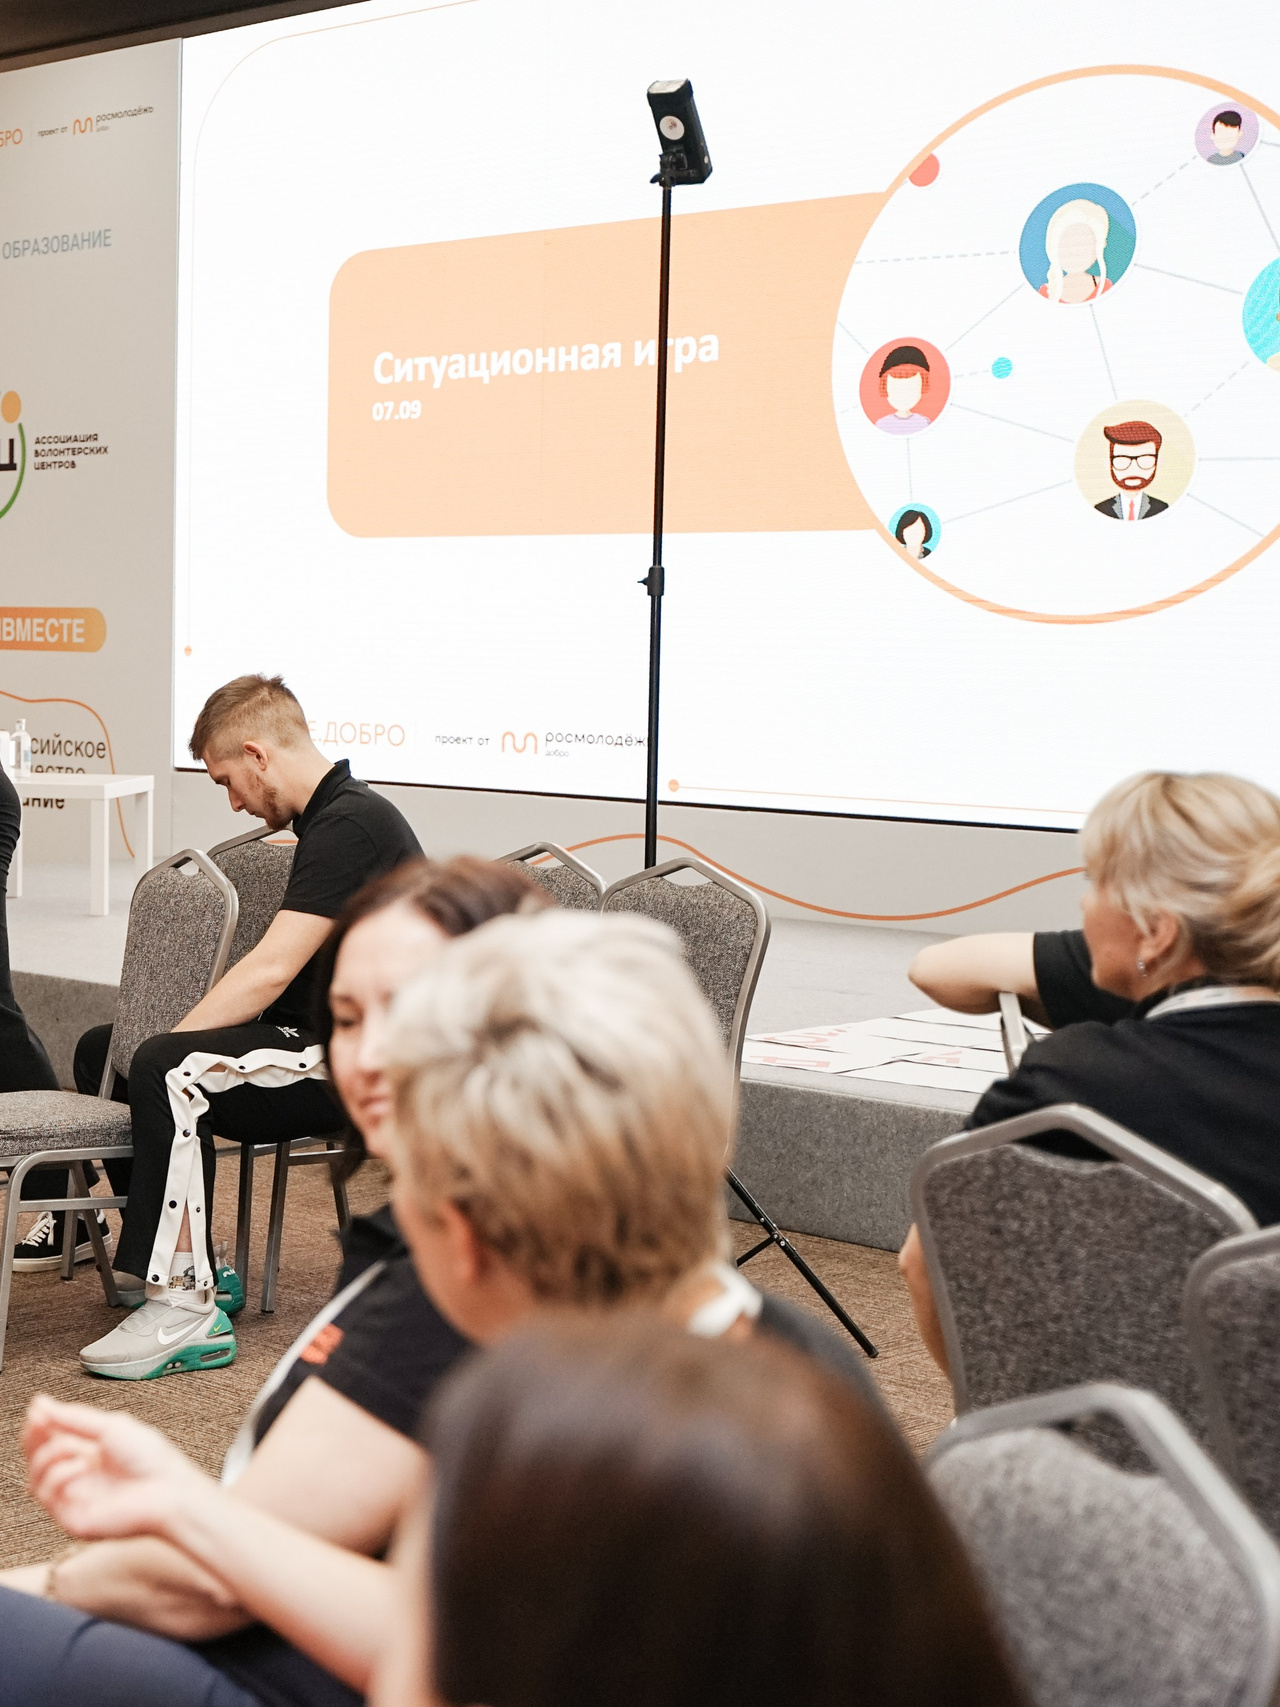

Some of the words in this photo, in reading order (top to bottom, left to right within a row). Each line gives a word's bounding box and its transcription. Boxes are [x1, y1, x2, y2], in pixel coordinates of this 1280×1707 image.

[2, 229, 112, 260] ОБРАЗОВАНИЕ
[373, 341, 622, 388] Ситуационная
[633, 333, 720, 373] ира
[372, 400, 422, 421] 07.09
[34, 433, 98, 445] АССОЦИАЦИЯ
[34, 446, 108, 458] ВОЛОНТЕРСКИХ
[34, 460, 77, 470] ЦЕНТРОВ
[435, 734, 473, 745] проект
[477, 736, 490, 745] от
[545, 732, 646, 748] росмолодёж
